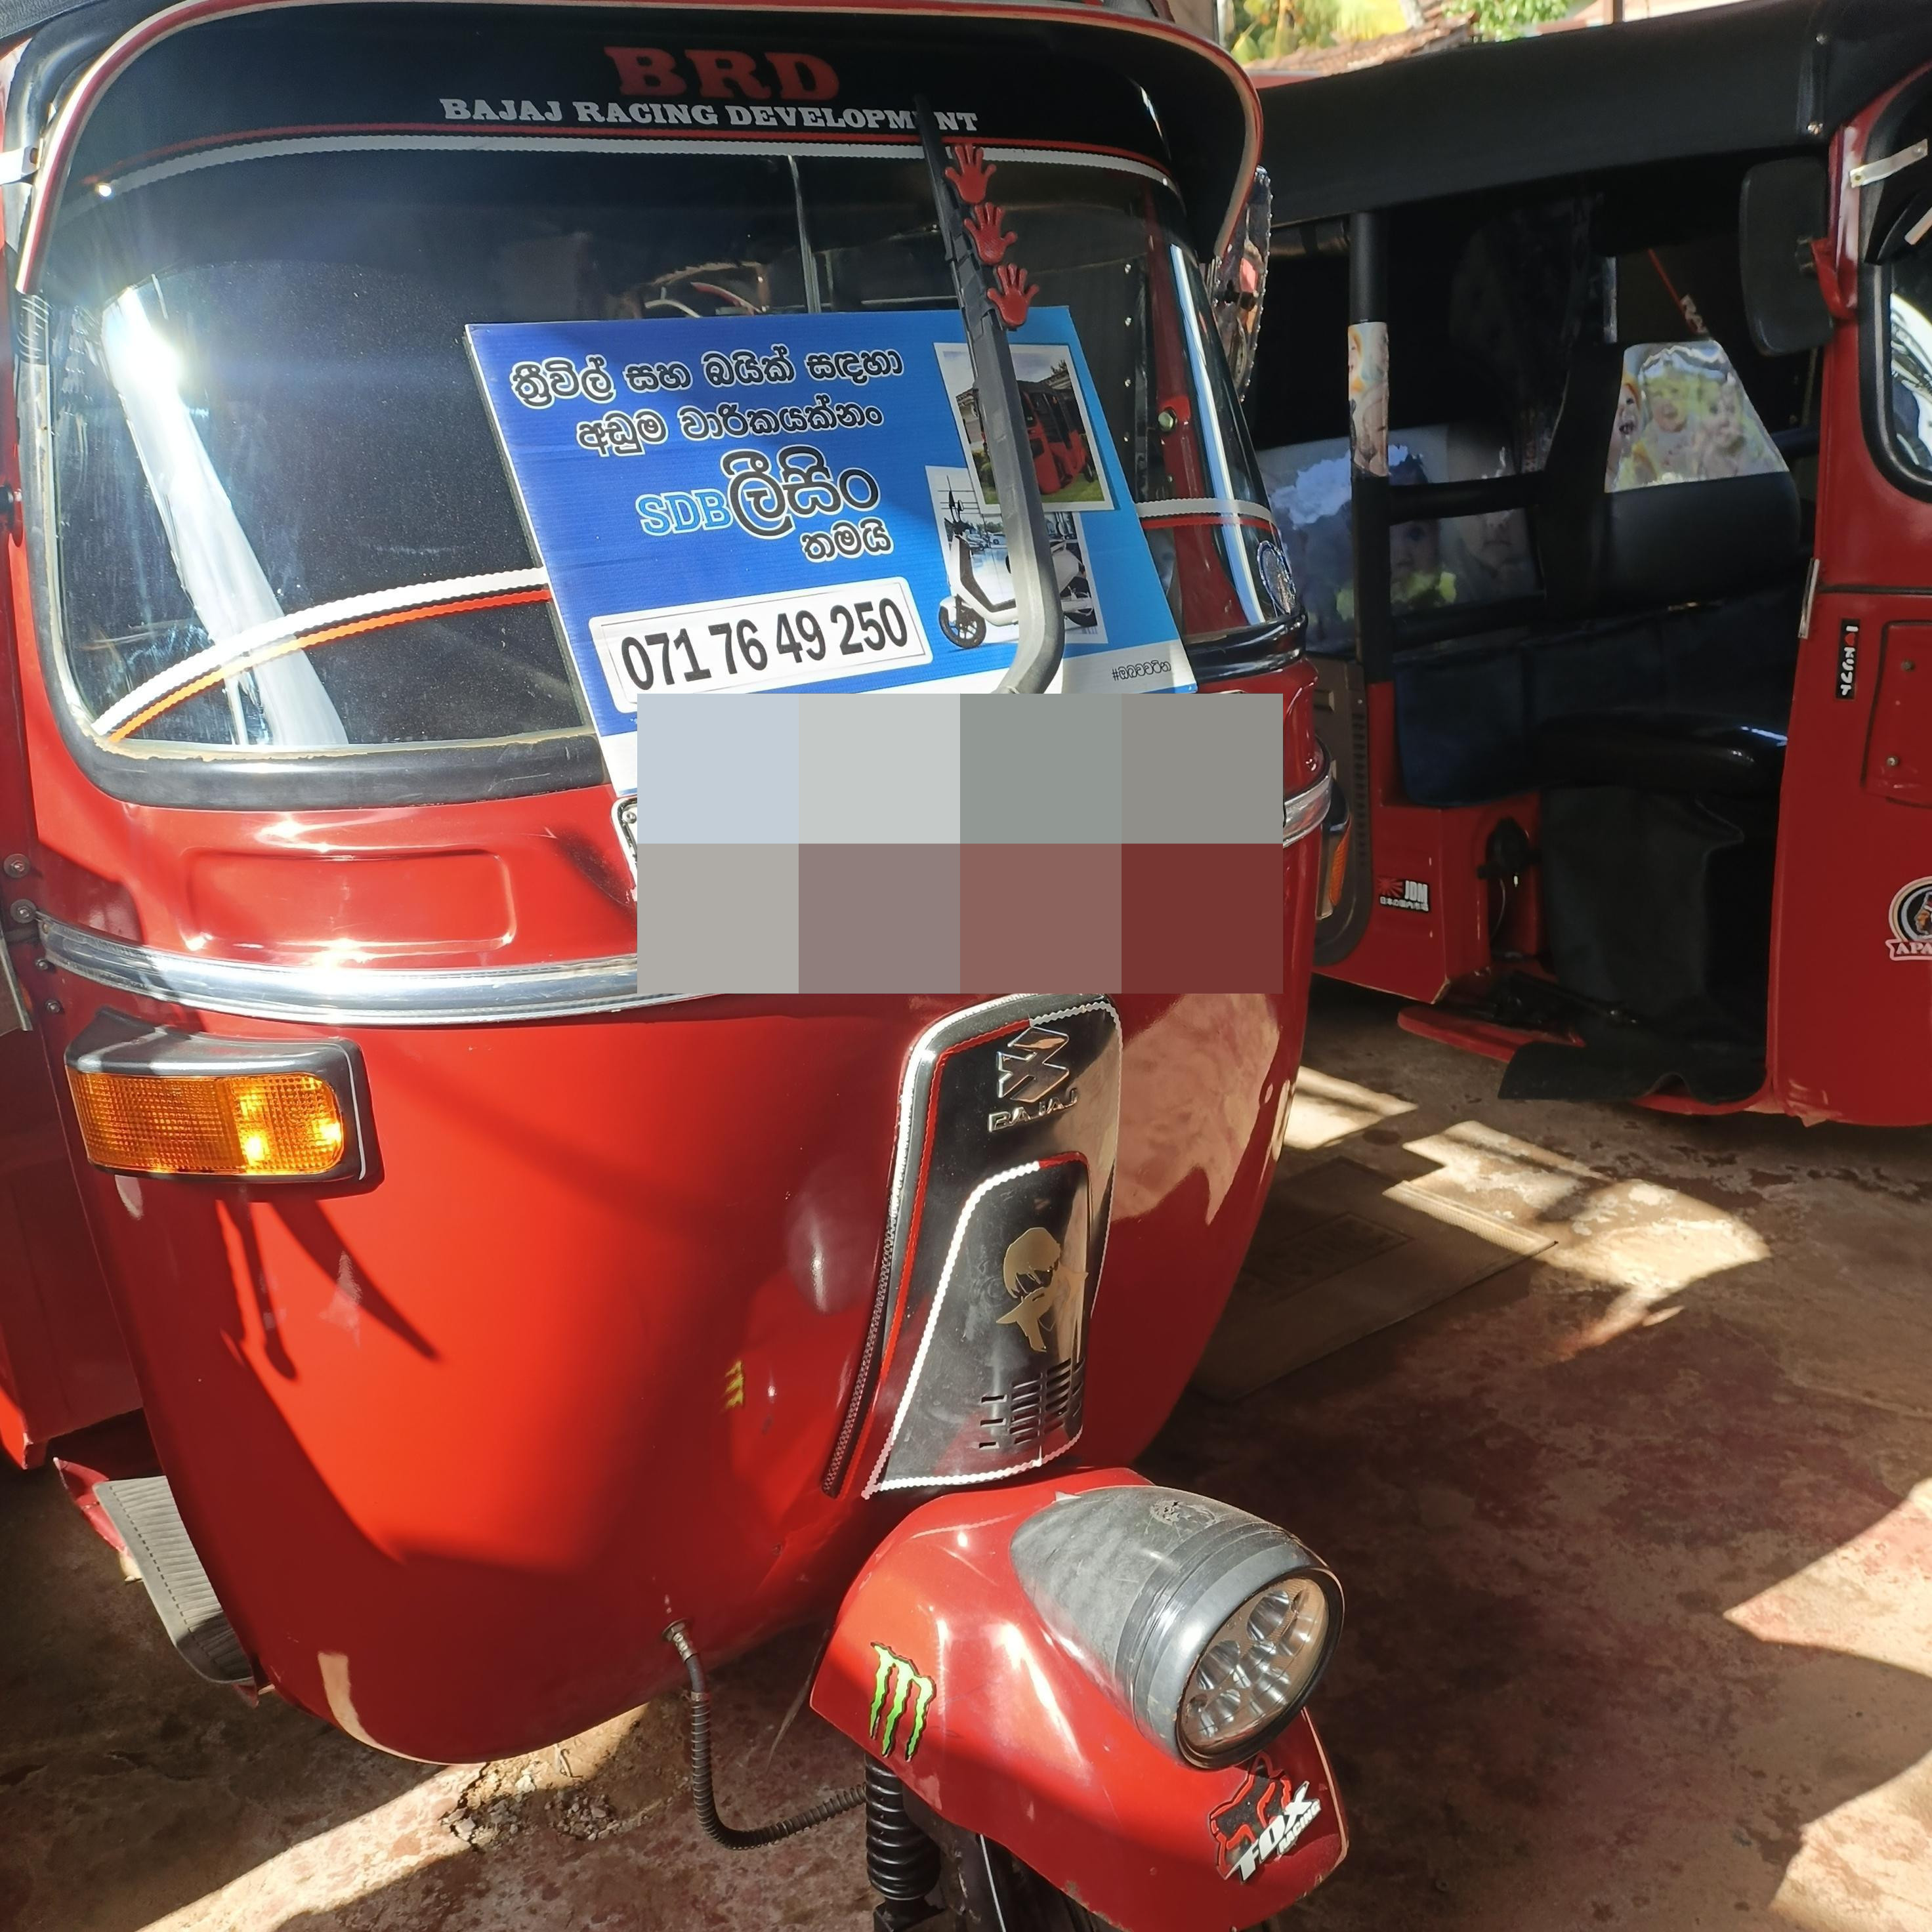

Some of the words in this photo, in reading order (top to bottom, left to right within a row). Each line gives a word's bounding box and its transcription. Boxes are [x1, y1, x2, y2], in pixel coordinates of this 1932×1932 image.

[604, 46, 839, 100] BRD
[439, 98, 562, 122] BAJAJ
[572, 100, 719, 127] RACING
[724, 105, 978, 131] DEVELOPMNT
[623, 363, 693, 393] සහ
[805, 348, 904, 386] සඳහා
[577, 408, 668, 457] අඩුම
[677, 394, 884, 441] වාරිකයක්නං
[800, 516, 894, 563] තමයි
[621, 628, 712, 690] 071
[708, 619, 768, 675] 76
[776, 610, 826, 663] 49
[830, 598, 908, 655] 250
[1225, 1780, 1314, 1881] FOX
[1277, 1799, 1322, 1855] RACING
